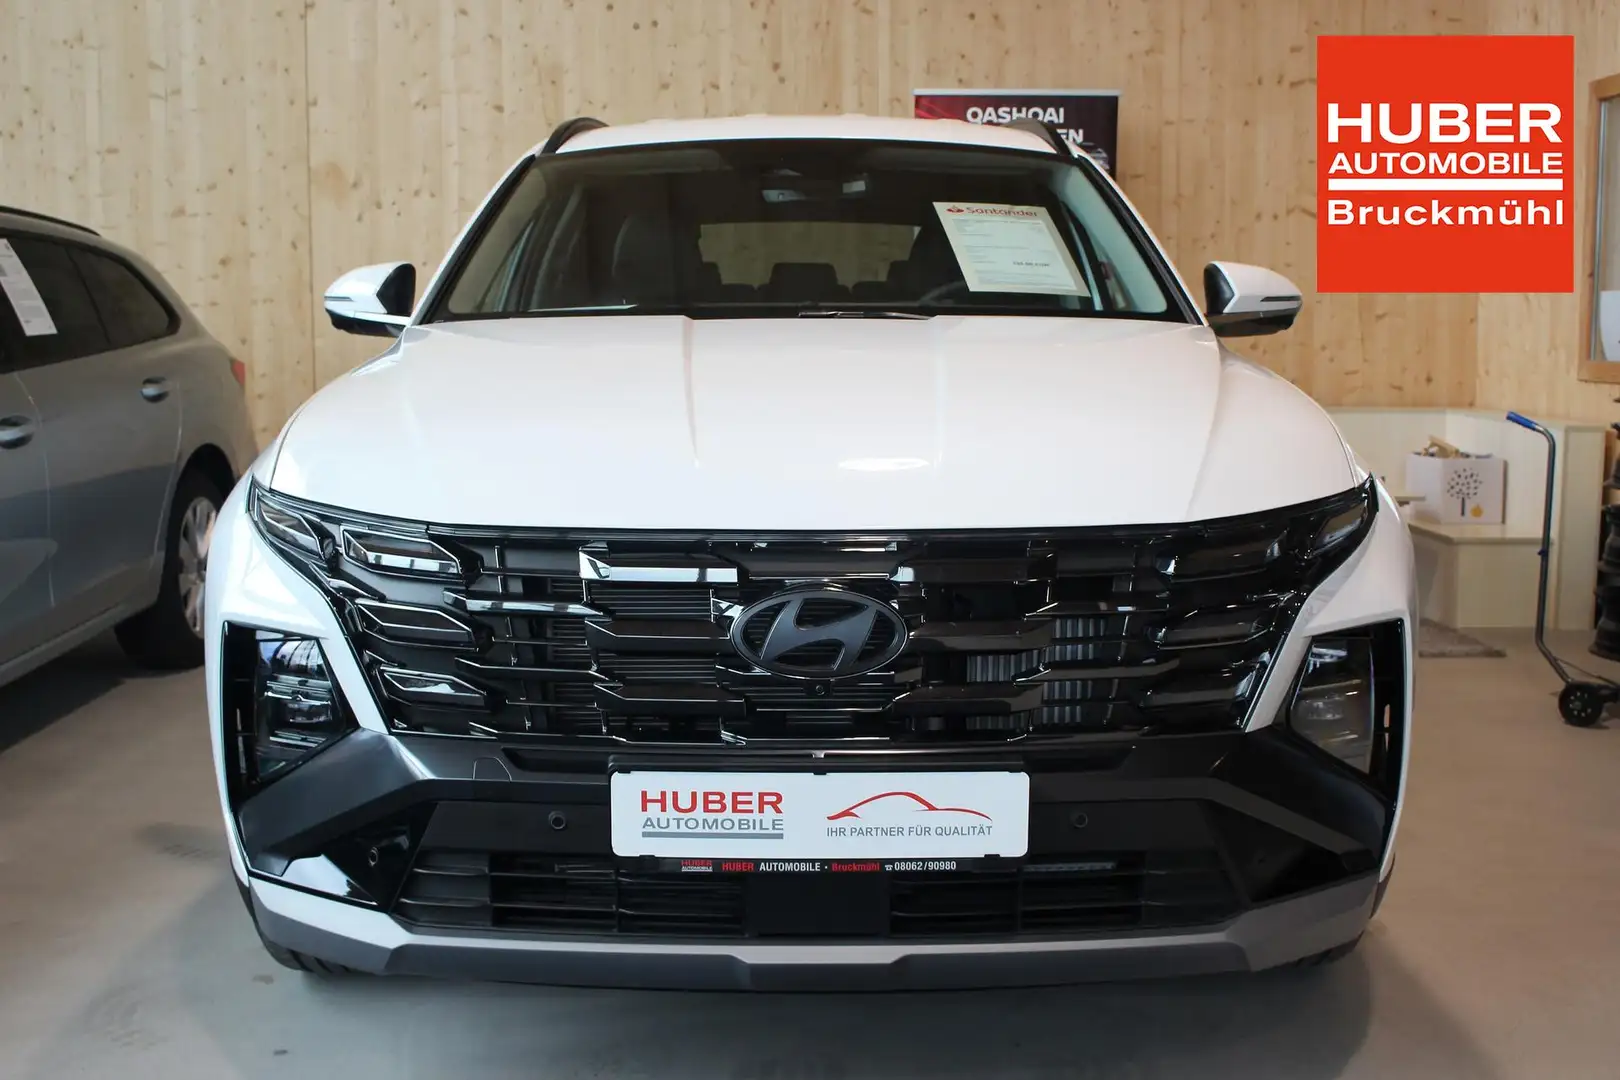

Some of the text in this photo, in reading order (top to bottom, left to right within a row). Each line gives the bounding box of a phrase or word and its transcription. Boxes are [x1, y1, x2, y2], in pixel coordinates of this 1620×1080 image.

[966, 206, 1038, 217] Santander
[640, 790, 783, 814] HUBER
[642, 817, 784, 831] AUTOMOBILE
[826, 824, 993, 837] IHR PARTNER FÜR QUALITÄT
[722, 861, 957, 871] HUBER AUTOMOBILE Bruckmühl 08062/90980
